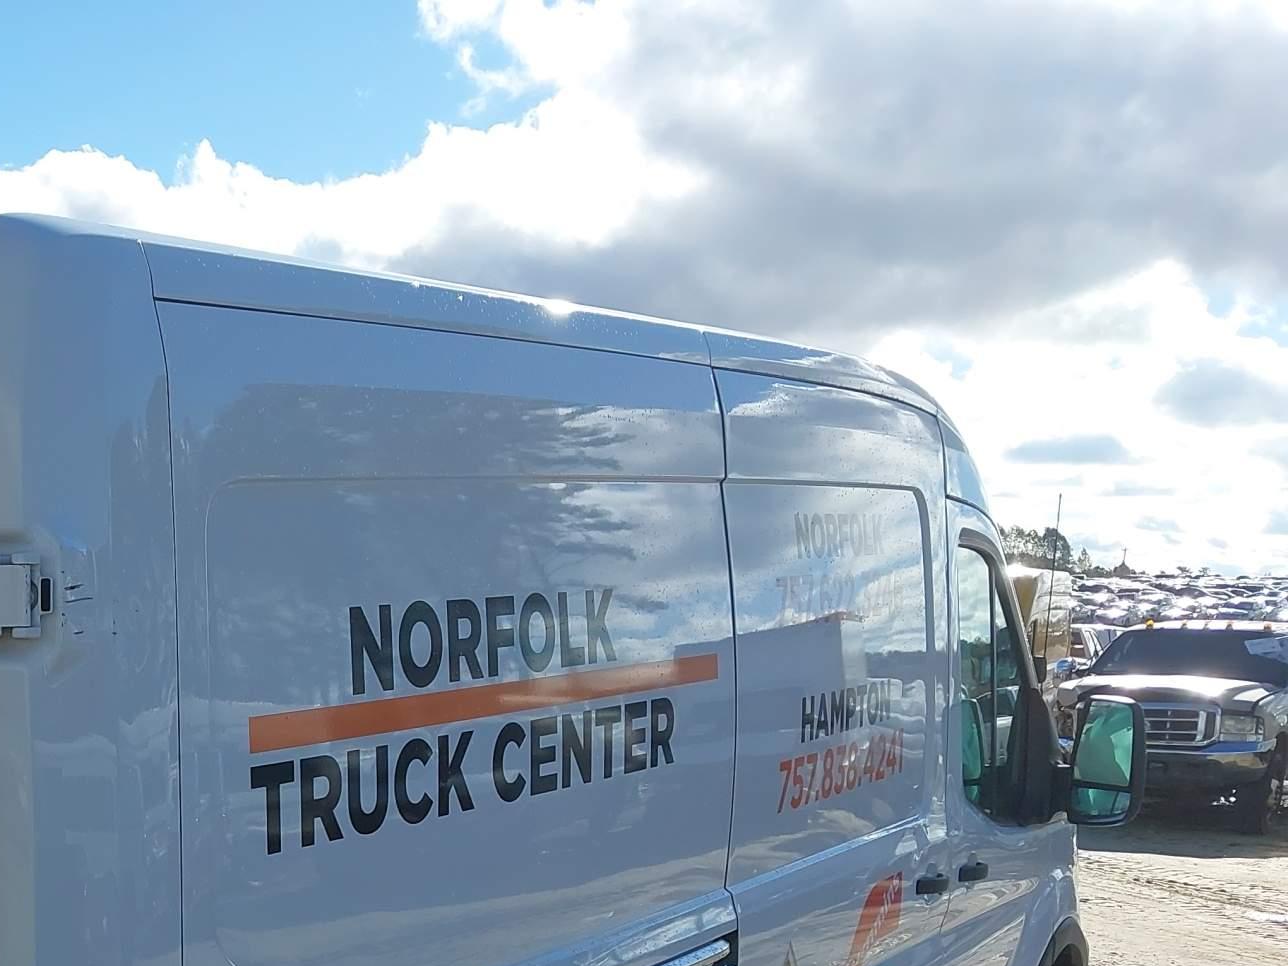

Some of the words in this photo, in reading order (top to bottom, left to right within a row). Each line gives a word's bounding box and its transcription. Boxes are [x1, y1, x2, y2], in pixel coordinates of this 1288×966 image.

[793, 512, 884, 559] NORFOLK
[349, 588, 617, 696] NORFOLK
[801, 679, 891, 743] HAMPTON
[250, 730, 475, 856] TRUCK
[492, 697, 676, 803] CENTER
